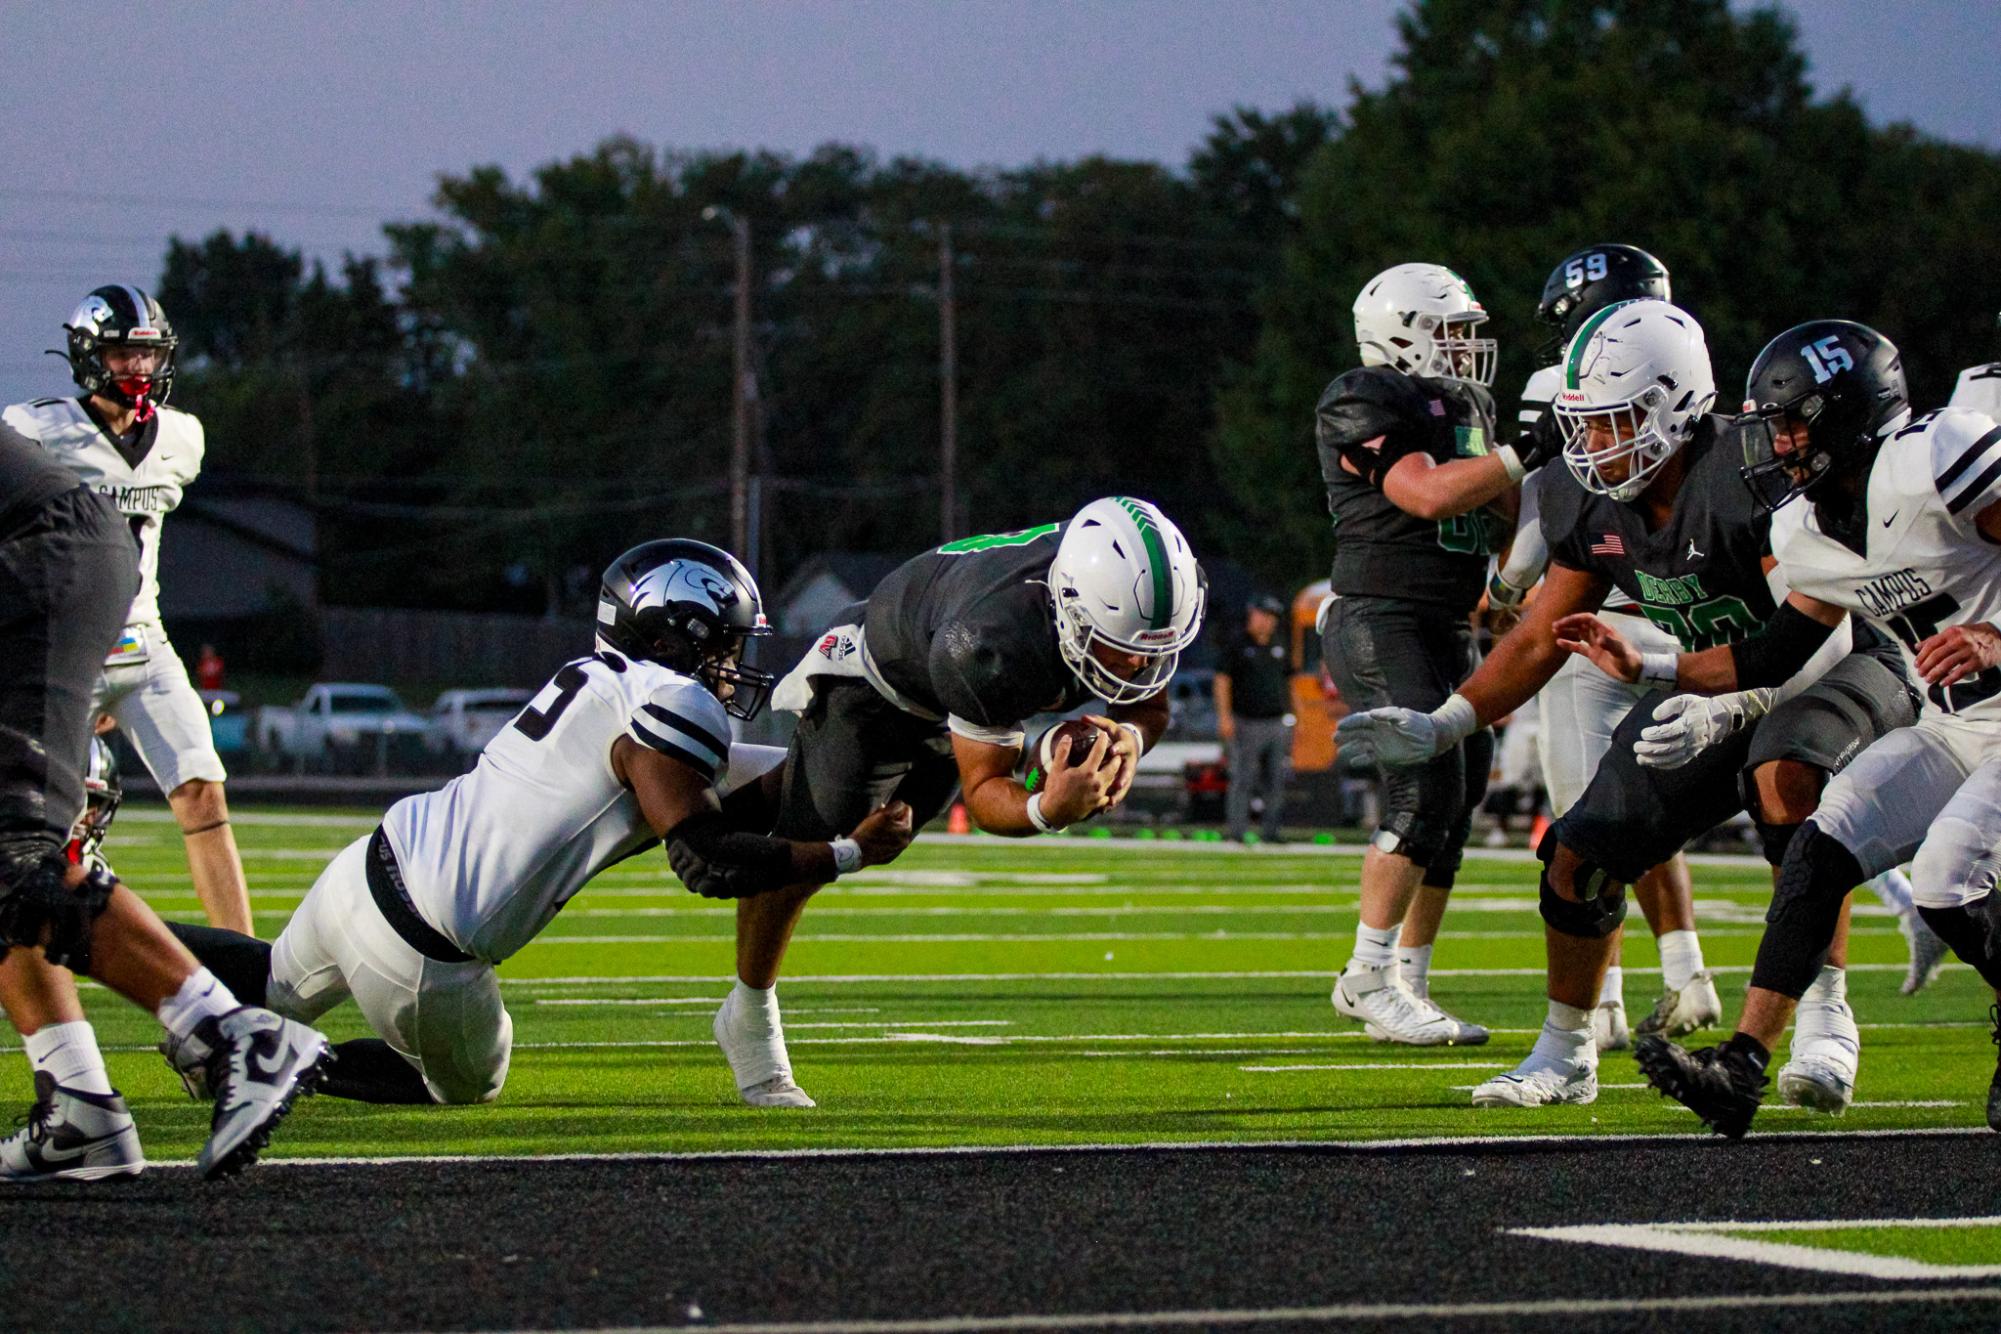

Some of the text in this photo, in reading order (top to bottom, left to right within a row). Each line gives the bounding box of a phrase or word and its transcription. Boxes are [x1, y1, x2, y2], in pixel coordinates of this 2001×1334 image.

[1566, 253, 1607, 288] 59
[1800, 335, 1853, 384] 15
[1634, 570, 1708, 604] DERBY
[1854, 568, 1932, 617] CAMPUS
